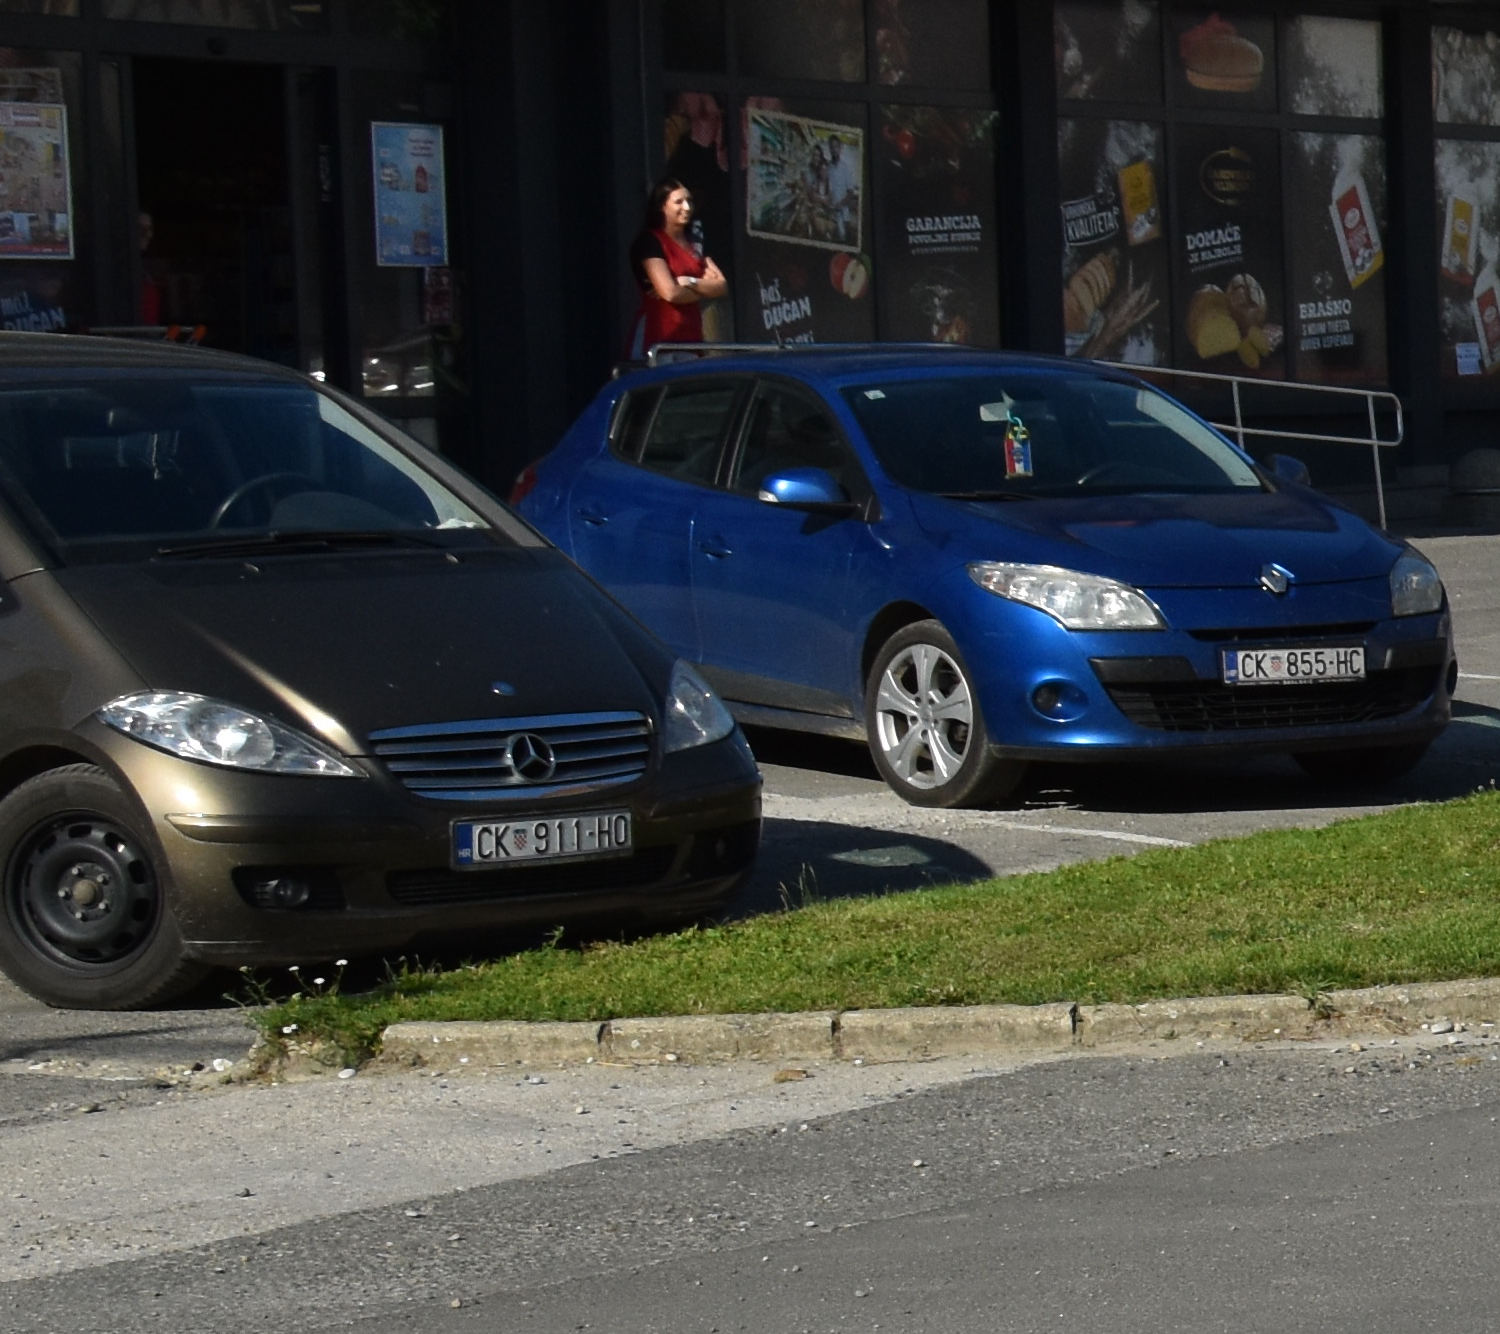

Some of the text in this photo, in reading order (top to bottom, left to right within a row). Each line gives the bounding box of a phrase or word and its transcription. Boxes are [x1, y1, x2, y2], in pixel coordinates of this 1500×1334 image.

[905, 214, 982, 233] GARANCIJA
[1299, 295, 1352, 320] BRAŠNO
[1241, 649, 1361, 678] CK 855-HC
[477, 815, 628, 859] CK 911-HO
[458, 848, 472, 858] HR
